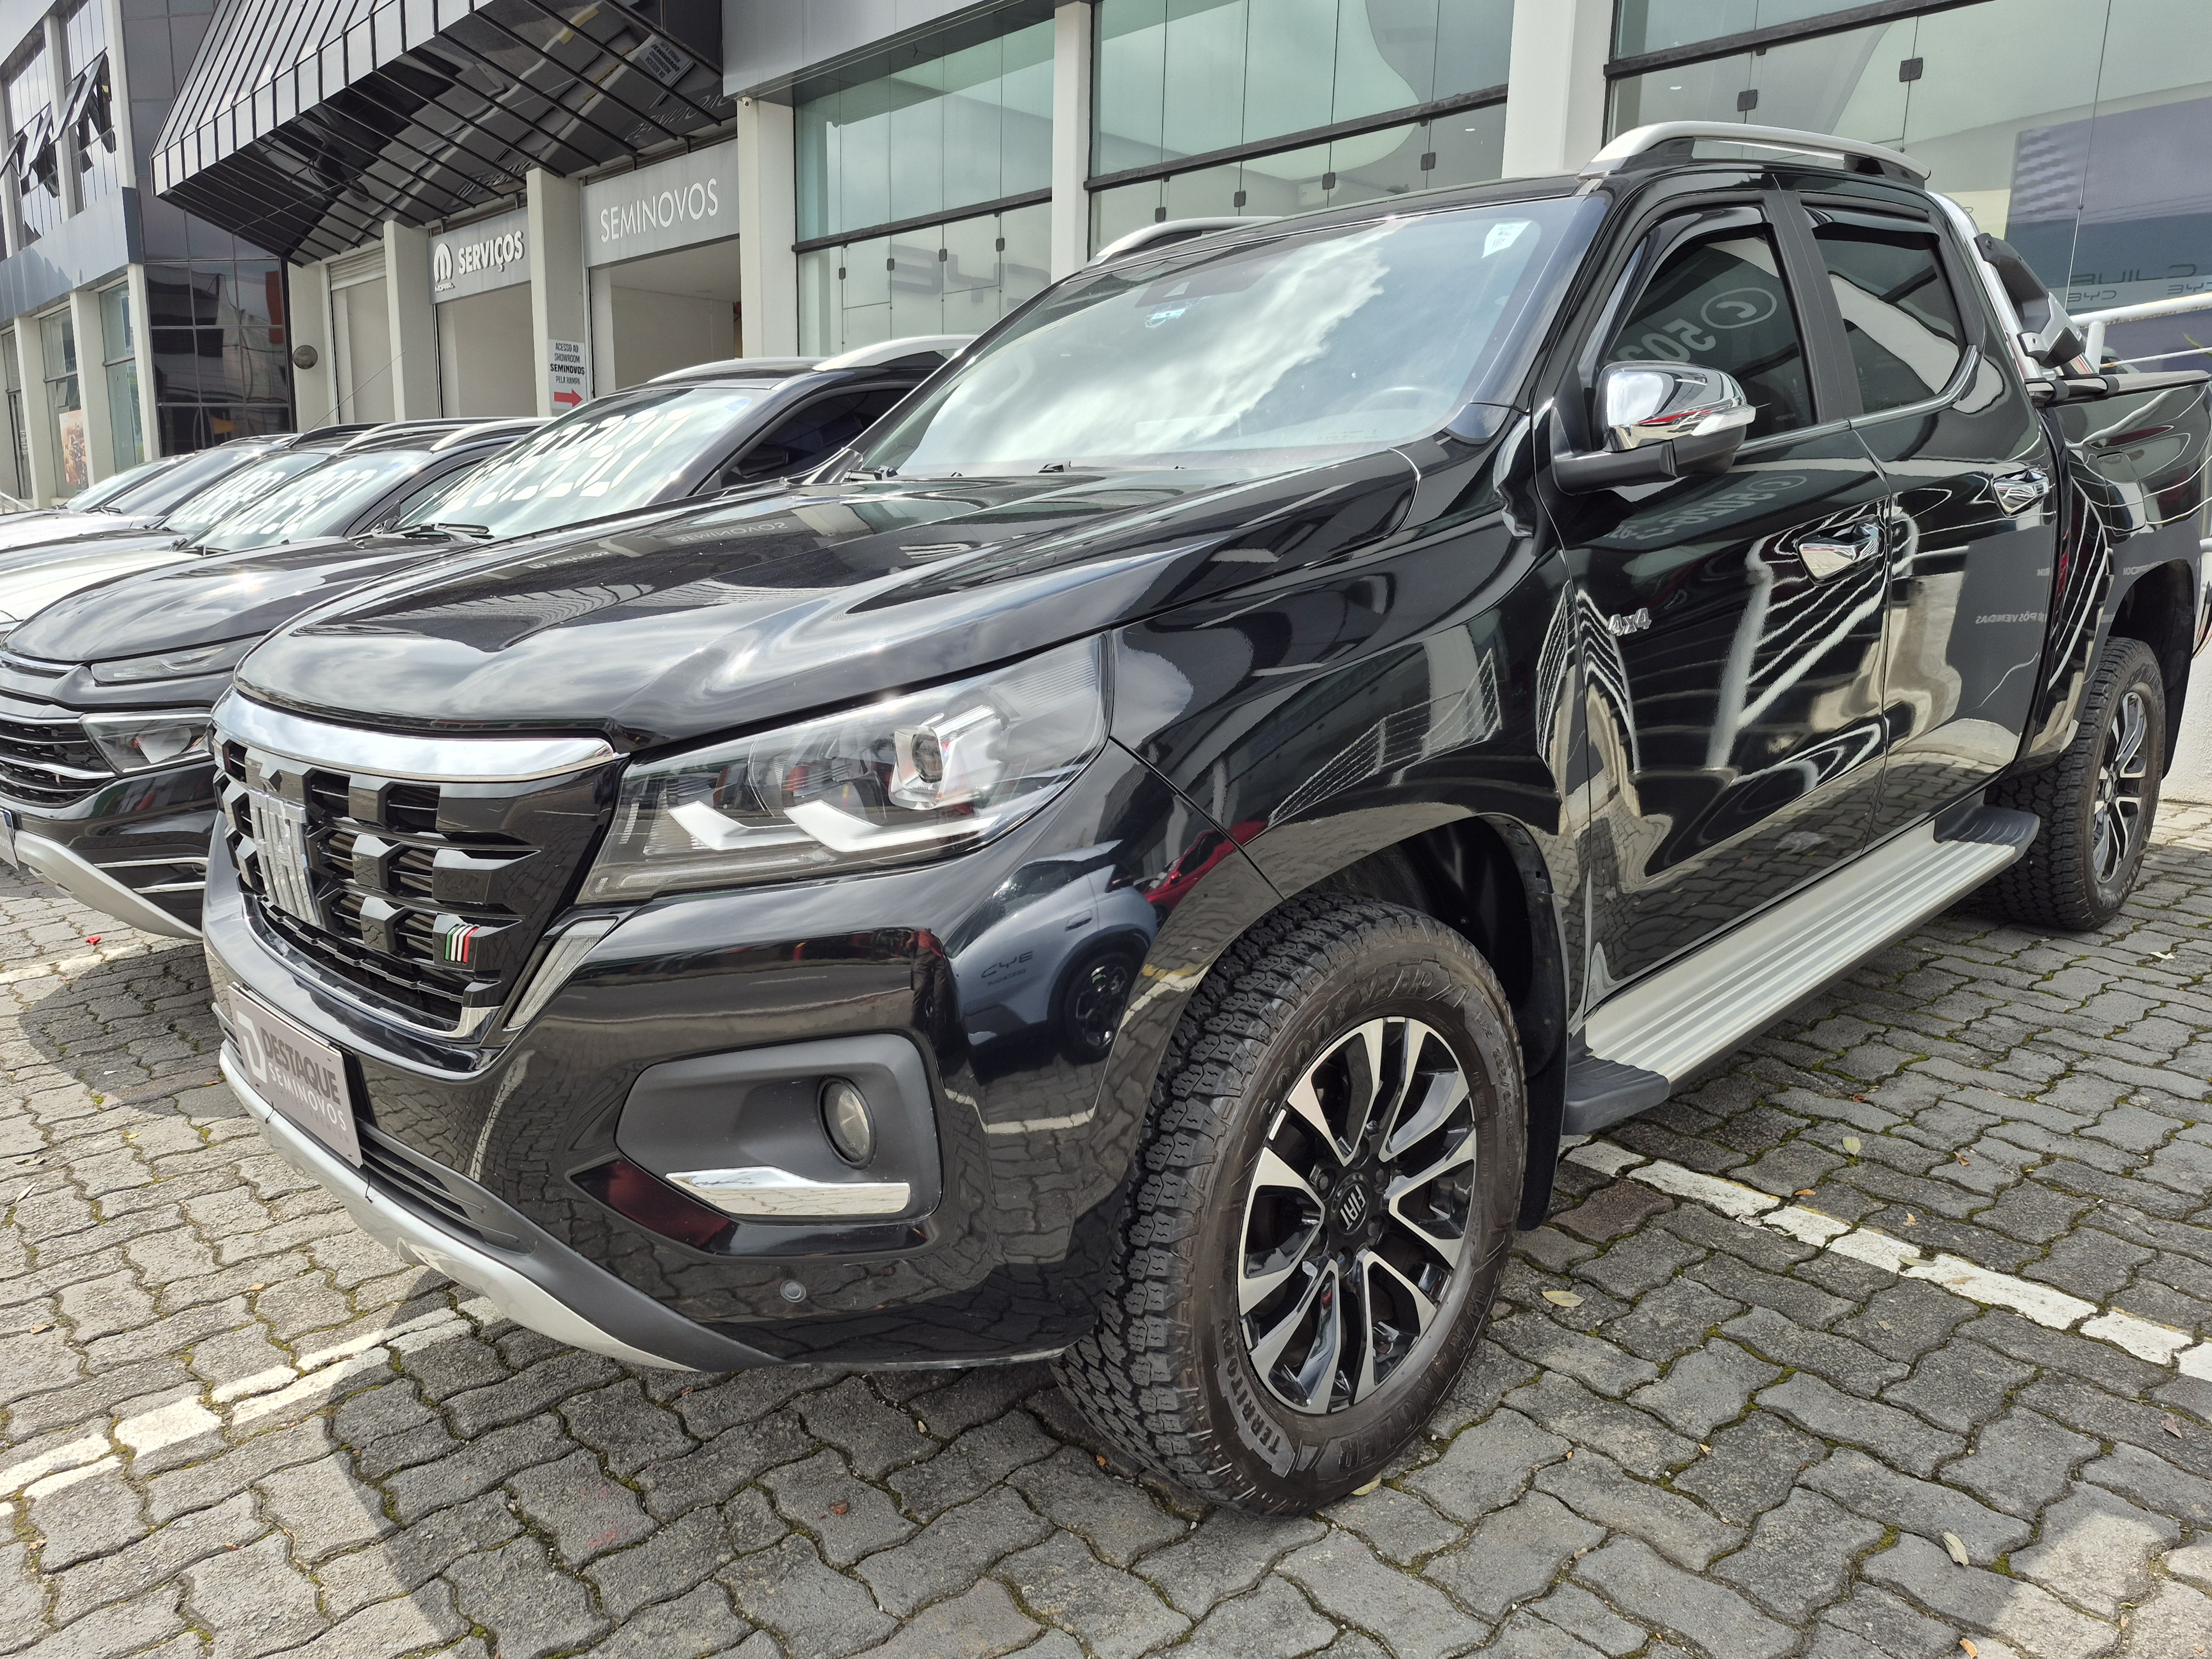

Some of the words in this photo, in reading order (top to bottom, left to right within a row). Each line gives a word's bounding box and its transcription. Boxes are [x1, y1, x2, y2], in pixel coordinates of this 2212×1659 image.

[601, 178, 718, 243] SEMINOVOS
[458, 231, 524, 273] SERVIÇOS
[2067, 290, 2117, 303] BYD
[554, 352, 580, 363] SHOWROOM
[555, 342, 572, 352] ACESSO
[573, 344, 578, 353] AO
[550, 363, 585, 375] SEMINOVOS
[556, 375, 566, 384] PELA
[566, 376, 581, 385] RAMPA
[1607, 607, 1652, 637] 4x4
[249, 789, 321, 927] FIAT
[260, 1026, 341, 1106] DESTAQUE
[268, 1062, 347, 1131] SEMINOVOS
[1339, 1184, 1366, 1231] FIAT
[1220, 1318, 1281, 1456] TERRITORY
